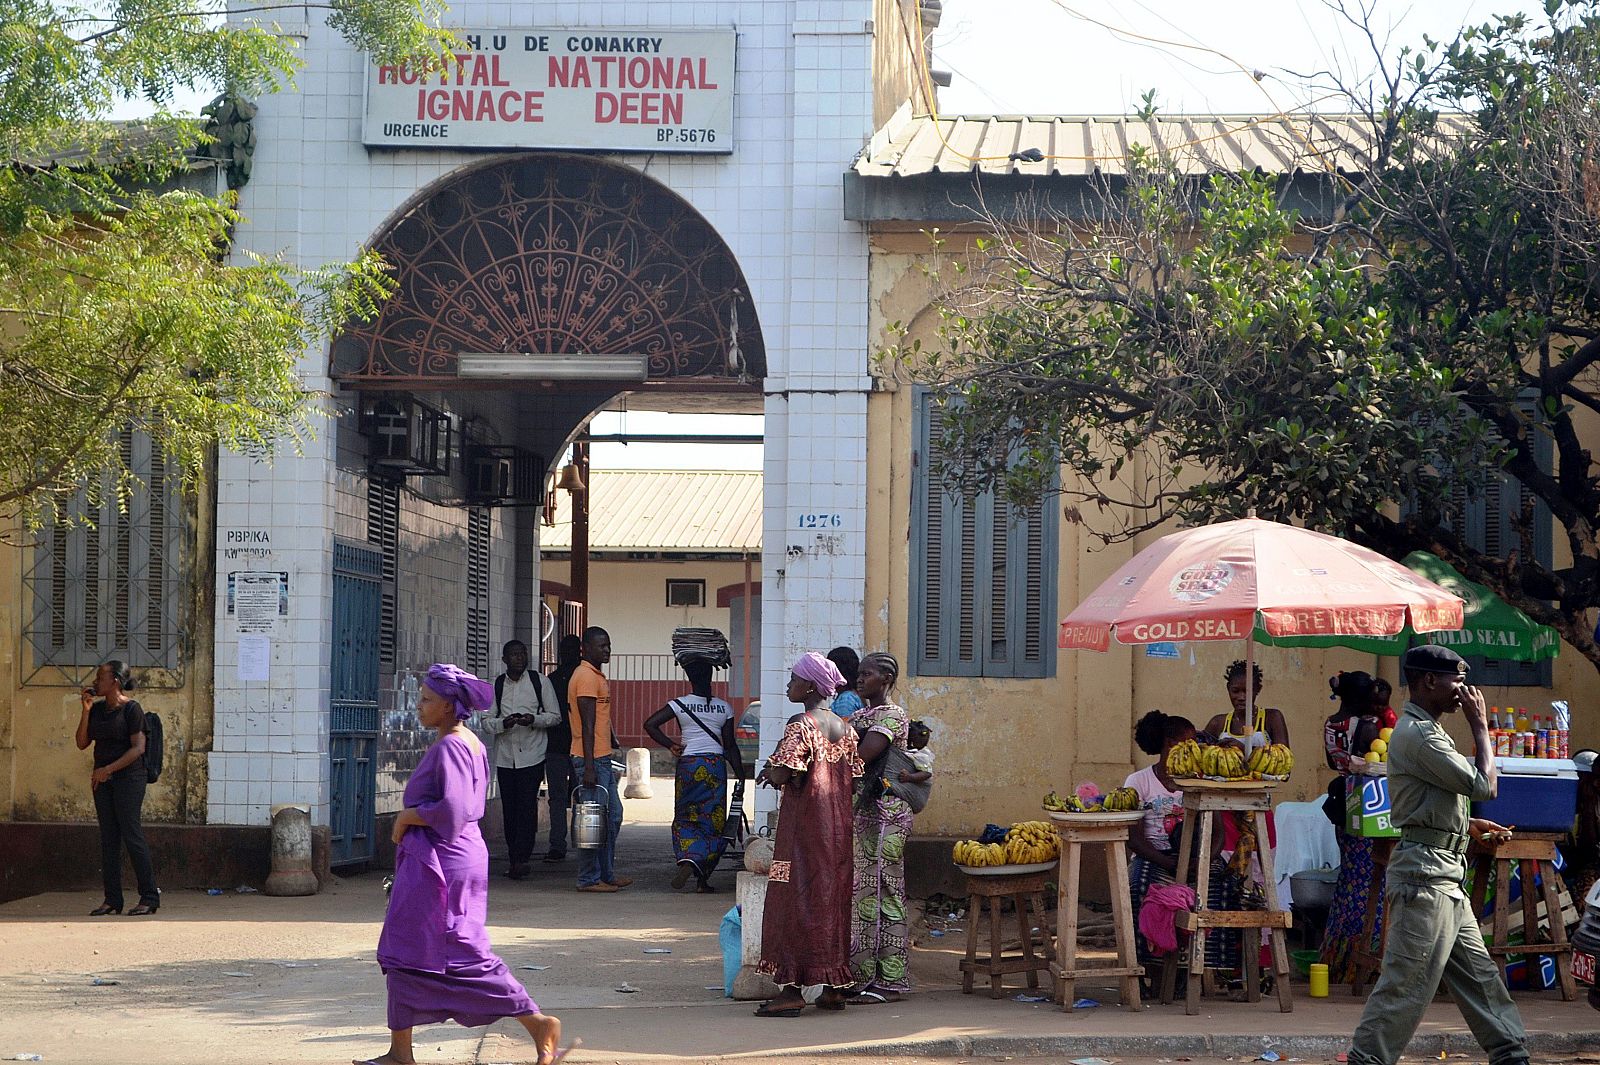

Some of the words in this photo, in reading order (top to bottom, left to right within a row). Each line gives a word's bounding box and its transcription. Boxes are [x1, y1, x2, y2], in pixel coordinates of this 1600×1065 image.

[524, 36, 549, 51] DE
[567, 36, 662, 52] CONAKRY
[548, 56, 717, 89] NATIONAL
[417, 89, 544, 122] IGNACE
[595, 92, 683, 124] DEEN
[383, 123, 448, 137] URGENCE
[657, 128, 716, 143] BP:5676
[799, 514, 841, 527] 1276
[1133, 622, 1190, 640] GOLD
[1194, 619, 1242, 637] SEAL
[1477, 629, 1521, 647] SEAL
